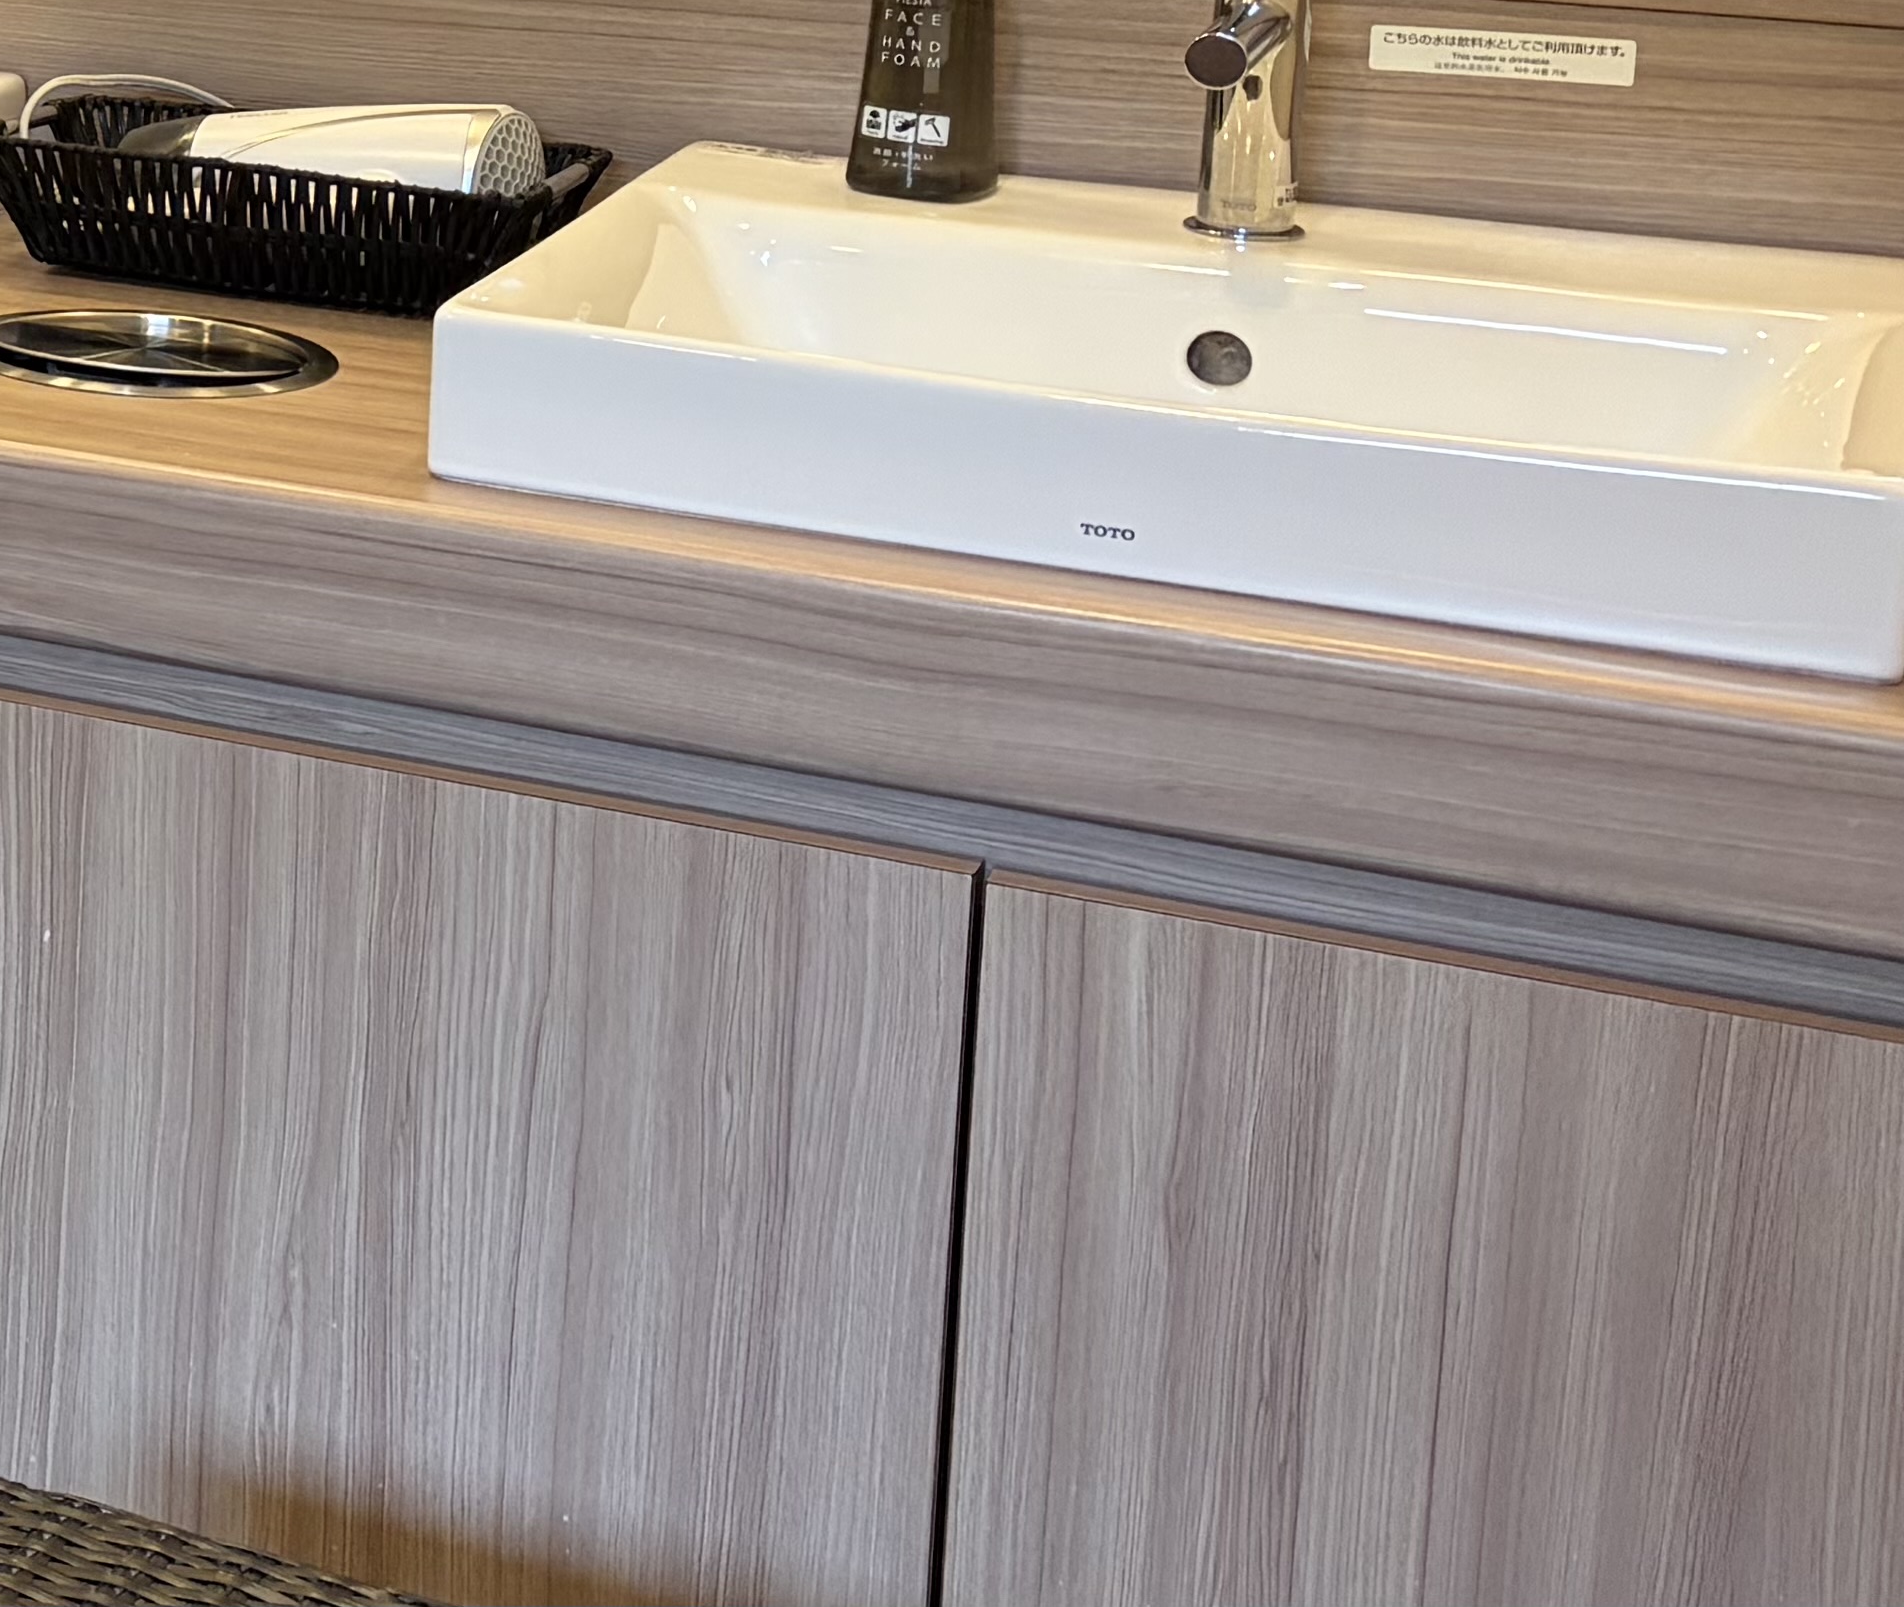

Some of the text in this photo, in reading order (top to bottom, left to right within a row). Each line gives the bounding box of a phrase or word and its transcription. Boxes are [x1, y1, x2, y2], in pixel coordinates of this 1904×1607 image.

[885, 8, 942, 27] FACE
[882, 35, 941, 53] HAND
[1383, 32, 1626, 58] こちらの水は飲料水としてご利用頂けます。
[881, 51, 941, 69] FOAM
[1080, 522, 1135, 541] TOTO
